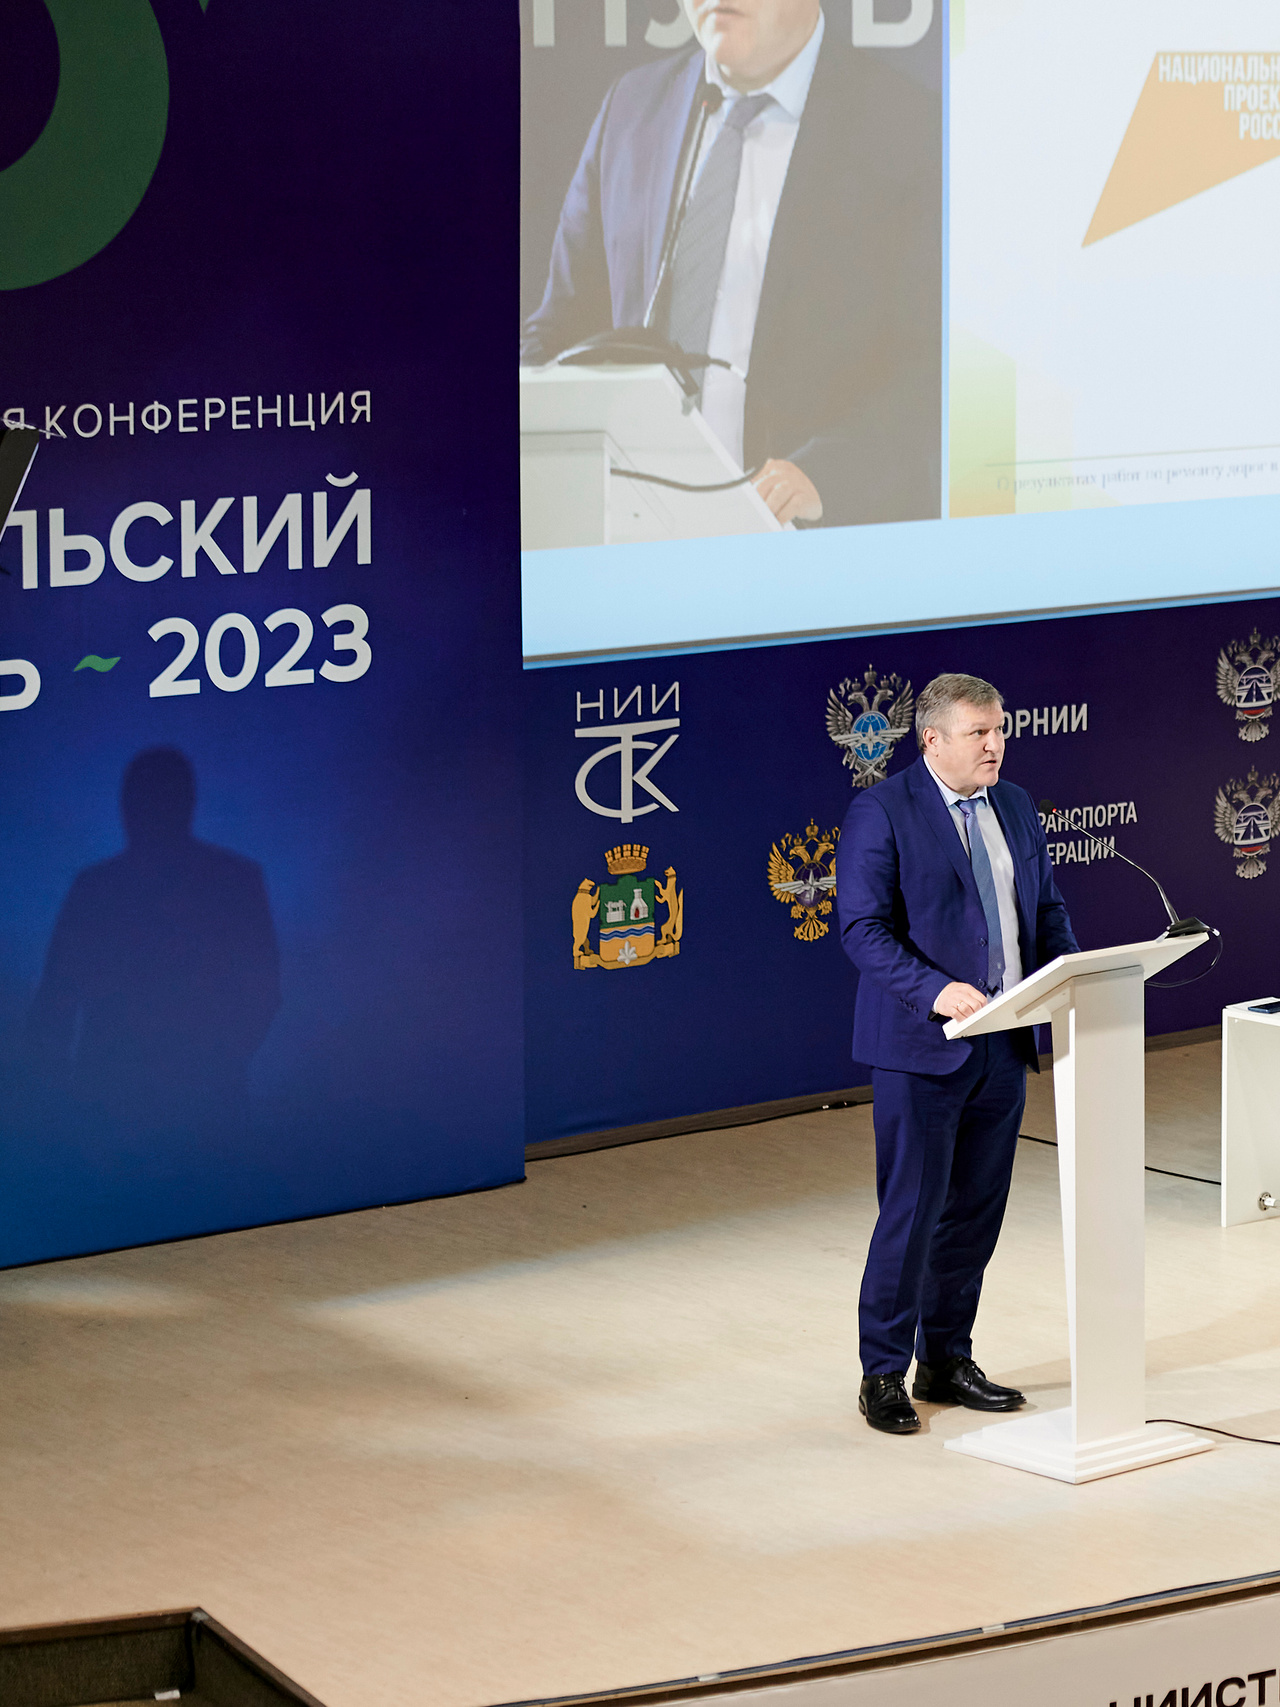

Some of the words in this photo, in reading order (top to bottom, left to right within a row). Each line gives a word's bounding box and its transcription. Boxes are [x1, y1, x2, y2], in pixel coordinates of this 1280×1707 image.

[45, 390, 372, 440] КОНФЕРЕНЦИЯ
[147, 603, 373, 698] 2023
[576, 681, 680, 722] НИИ
[1003, 703, 1088, 740] ОРНИИ
[1038, 801, 1137, 834] РАНСПОРТА
[1047, 836, 1115, 866] ЕРАЦИИ
